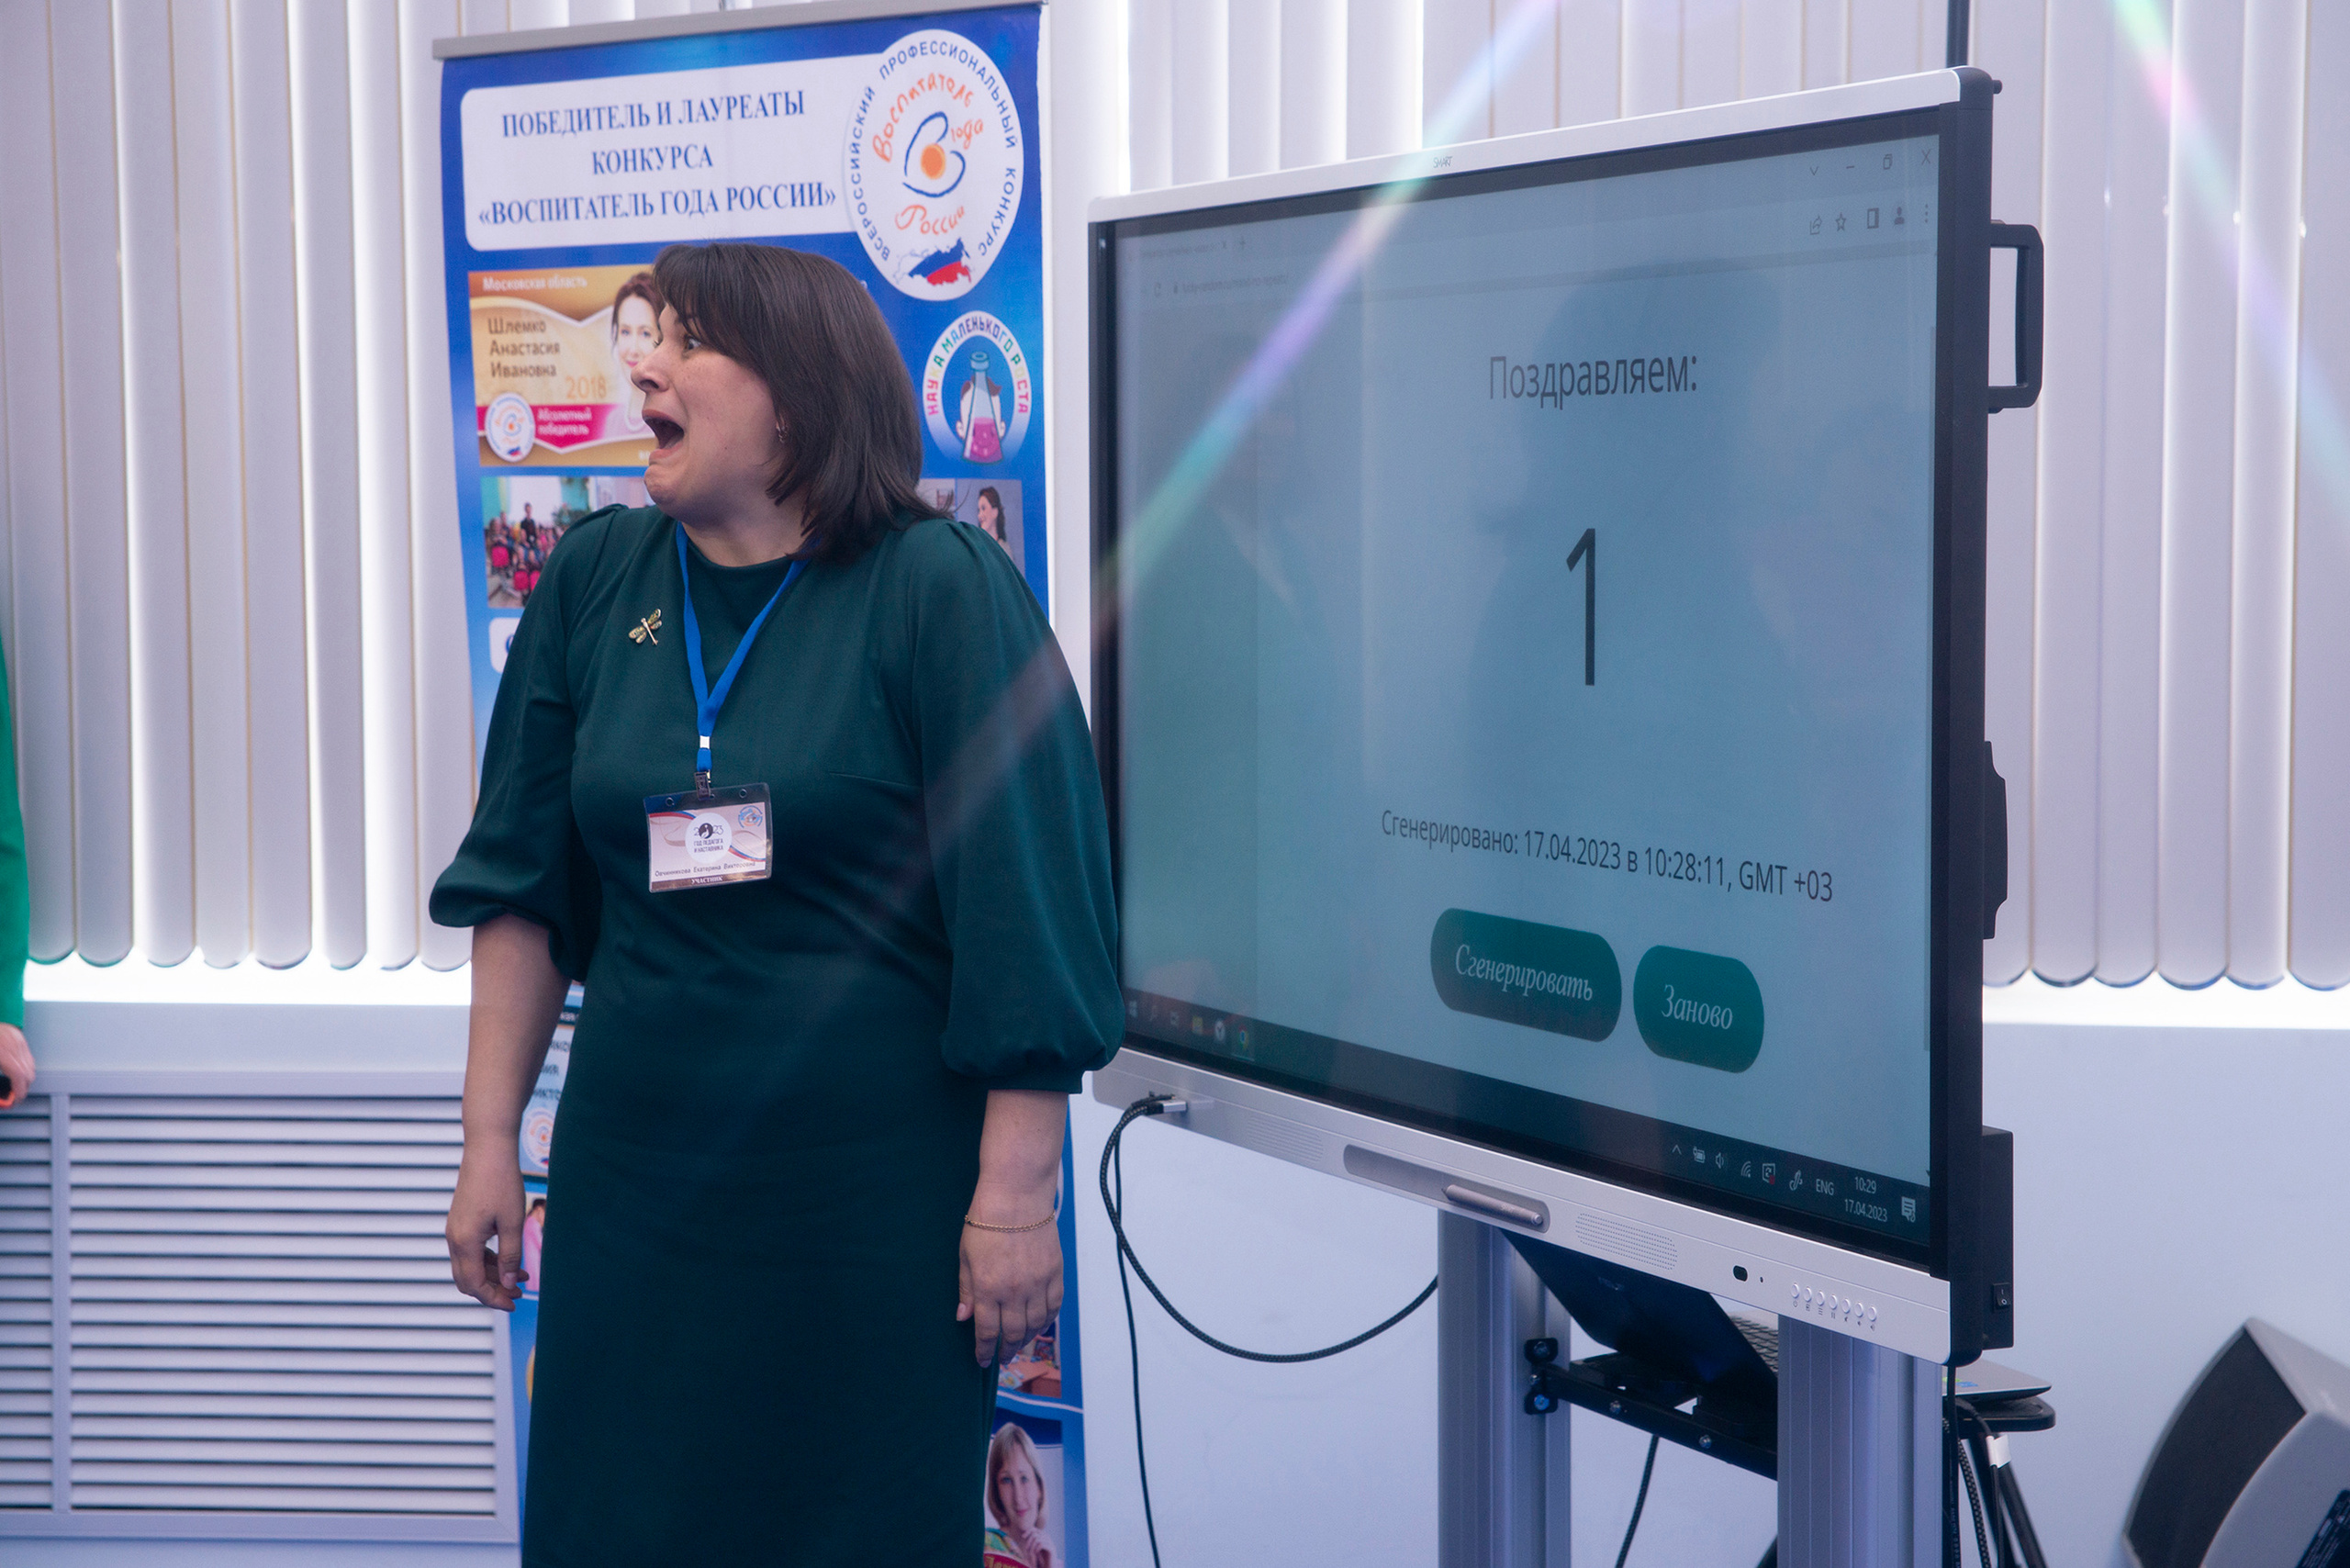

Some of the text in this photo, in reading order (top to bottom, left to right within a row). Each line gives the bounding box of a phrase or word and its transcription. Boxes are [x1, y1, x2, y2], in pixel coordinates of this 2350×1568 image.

[878, 40, 1017, 149] ПРОФЕССИОНАЛЬНЫЙ
[502, 90, 805, 139] ПОБЕДИТЕЛЬ И ЛАУРЕАТЫ
[591, 144, 714, 175] КОНКУРСА
[849, 85, 891, 262] ВСЕРОССИЙСКИЙ
[1433, 155, 1453, 169] SMART
[478, 181, 837, 226] «ВОСПИТАТЕЛЬ ГОДА РОССИИ»
[978, 167, 1017, 256] КОНКУРС
[482, 274, 588, 292] Московская область
[487, 318, 547, 335] Шлемко
[489, 339, 561, 357] Анастасия
[925, 316, 1029, 416] НАУКА МАЛЕНЬКОГО РОСТА
[490, 361, 557, 378] Ивановна
[565, 375, 608, 400] 2018
[1490, 354, 1697, 411] Поздравляем:
[1566, 528, 1596, 687] 1
[1382, 810, 1833, 902] Сгенерировано: 17.04.2023 в 10:28:11, GMT +03
[691, 875, 723, 885] УЧАСТНИК
[1455, 944, 1594, 1002] Сгенерировать
[1661, 984, 1733, 1030] Заново
[1816, 1178, 1835, 1196] ENG
[1854, 1175, 1877, 1194] 10:29
[1843, 1198, 1888, 1223] 17.04.2023
